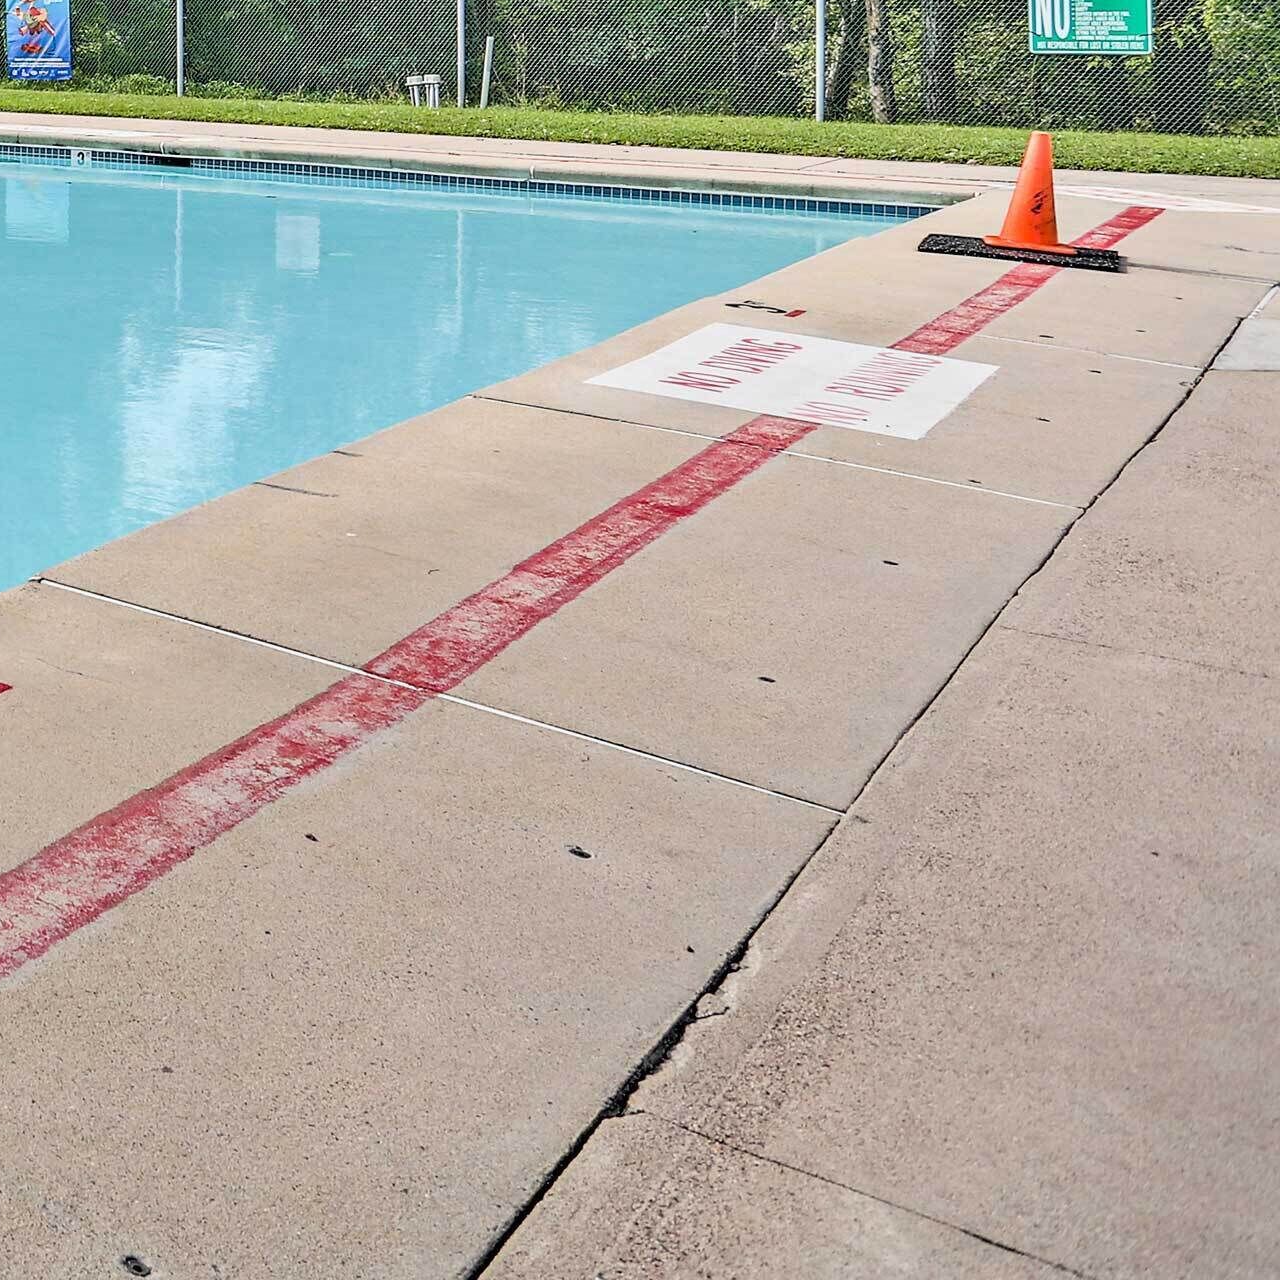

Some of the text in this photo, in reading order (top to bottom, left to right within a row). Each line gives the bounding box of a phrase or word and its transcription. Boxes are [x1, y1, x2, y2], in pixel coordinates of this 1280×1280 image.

[658, 338, 803, 393] NO DIVING
[787, 352, 943, 425] NO RUNNING
